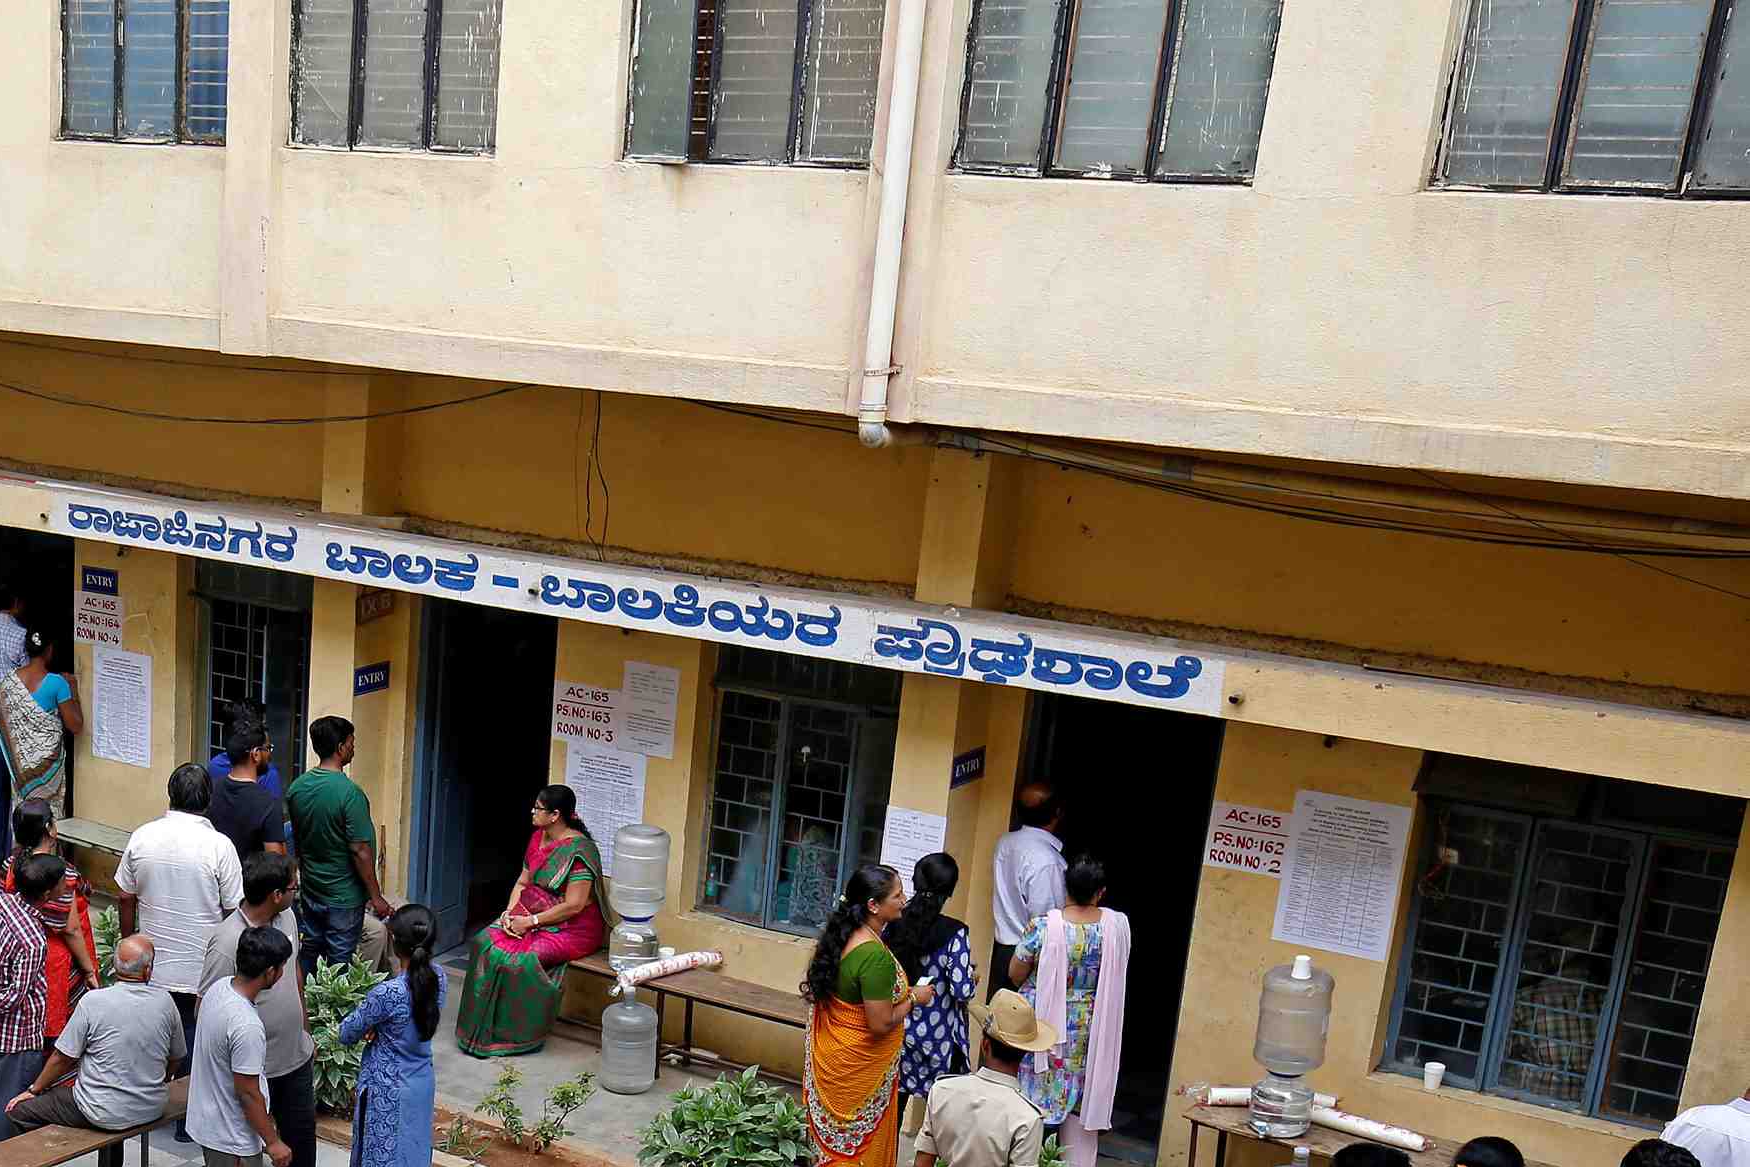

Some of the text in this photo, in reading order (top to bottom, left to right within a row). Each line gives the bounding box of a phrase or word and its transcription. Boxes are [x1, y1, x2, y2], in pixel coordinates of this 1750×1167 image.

[85, 573, 114, 588] ENTRY
[67, 503, 298, 563] ರಾಜಾಜಿನಗರ
[325, 542, 479, 592] ಬಾಲಕ
[540, 575, 841, 647] ಬಾಲಕಿಯರ
[874, 618, 1204, 700] ಪ್ರೌಢಶಾಲೆ
[76, 626, 96, 641] ROOM
[358, 671, 385, 687] ENTRY
[565, 686, 610, 703] AC-165
[556, 721, 584, 738] ROOM
[1225, 808, 1282, 829] AC-165
[1209, 848, 1243, 867] ROOM
